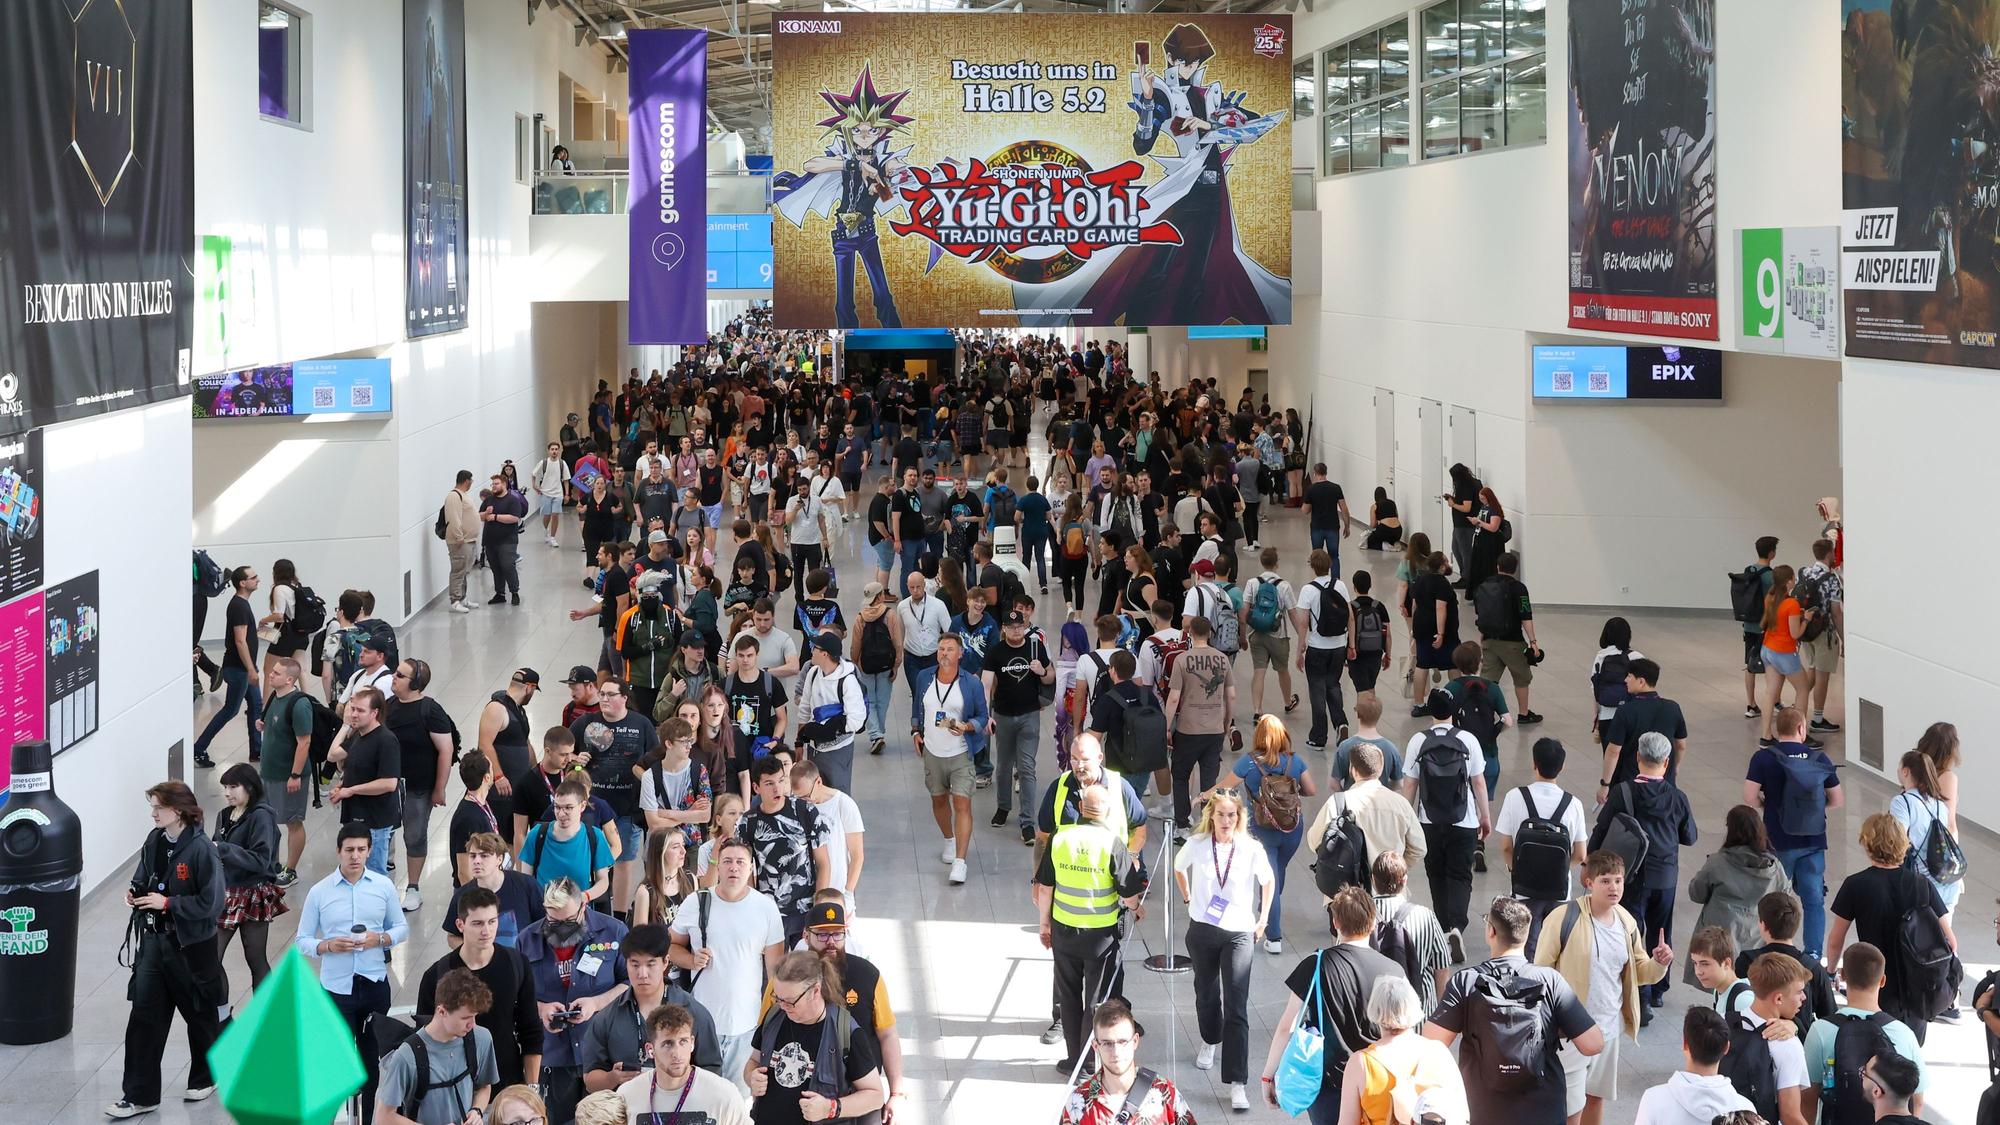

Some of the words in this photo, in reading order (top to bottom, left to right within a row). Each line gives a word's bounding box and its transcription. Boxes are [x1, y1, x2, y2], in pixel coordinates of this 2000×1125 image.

[779, 20, 841, 33] KONAMI
[951, 60, 1042, 80] Besucht
[1046, 64, 1088, 80] uns
[1092, 61, 1117, 80] in
[86, 60, 122, 116] VII
[963, 83, 1054, 112] Halle
[1061, 86, 1106, 113] 5.2
[660, 102, 680, 224] gamescom
[1594, 121, 1683, 214] VENOM
[992, 168, 1046, 179] SHONEN
[1047, 168, 1080, 179] JUMP
[931, 185, 1147, 228] Yu-Gi-Oh!
[938, 229, 1021, 243] TRADING
[1027, 229, 1079, 243] CARD
[1084, 229, 1139, 243] GAME
[1855, 214, 1894, 240] JETZT
[760, 263, 772, 282] 9
[1855, 258, 1935, 284] ANSPIELEN!
[24, 282, 84, 324] BESUCHT
[84, 281, 111, 320] UNS
[113, 281, 128, 318] IN
[130, 280, 164, 316] HALLE
[164, 279, 173, 314] 6
[1756, 257, 1780, 338] 9
[1681, 312, 1712, 328] SONY
[1960, 330, 1995, 347] CAPCOM
[1652, 364, 1696, 380] EPIX
[216, 408, 226, 416] IN
[228, 407, 257, 416] JEDER
[1001, 664, 1029, 672] gamesco
[1186, 655, 1226, 671] CHASE
[25, 931, 46, 940] DEIN
[0, 940, 47, 954] FAND
